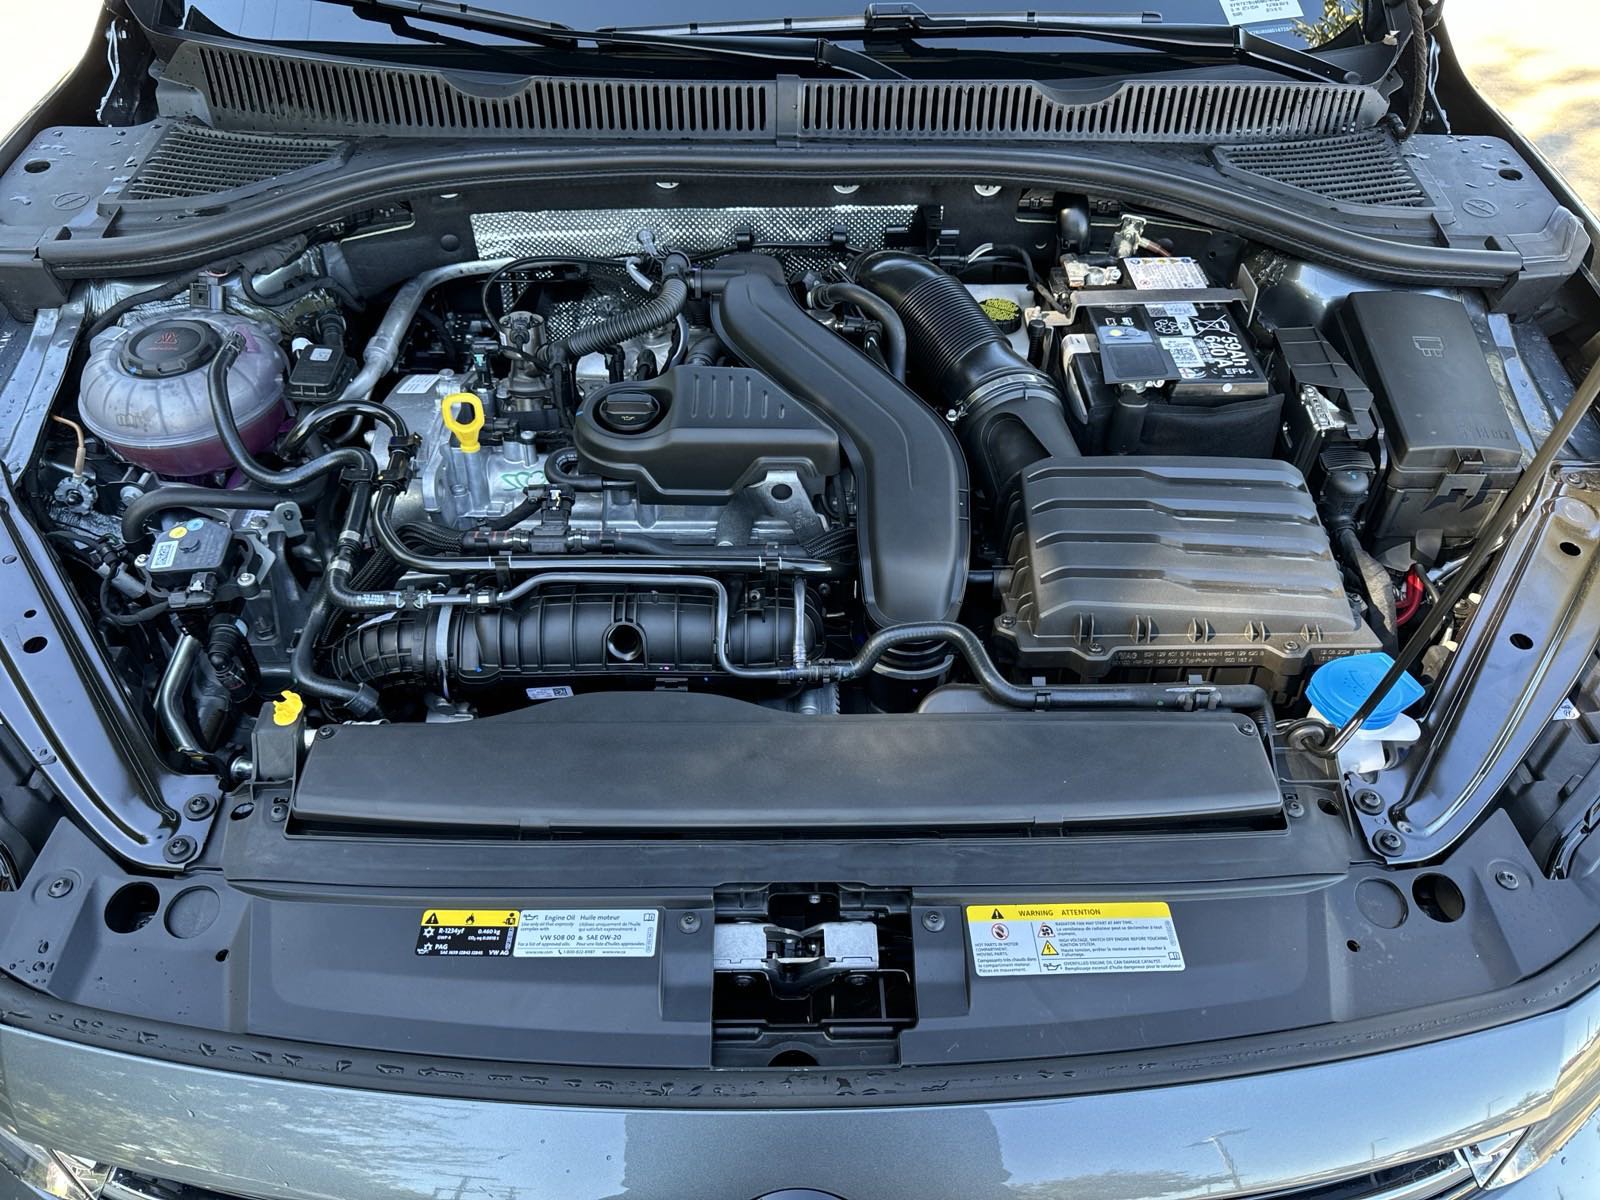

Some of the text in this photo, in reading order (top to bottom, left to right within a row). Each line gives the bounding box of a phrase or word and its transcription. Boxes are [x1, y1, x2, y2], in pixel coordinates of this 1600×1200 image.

[1204, 336, 1228, 356] 640
[1221, 336, 1249, 366] 59Ah
[1214, 358, 1233, 367] A
